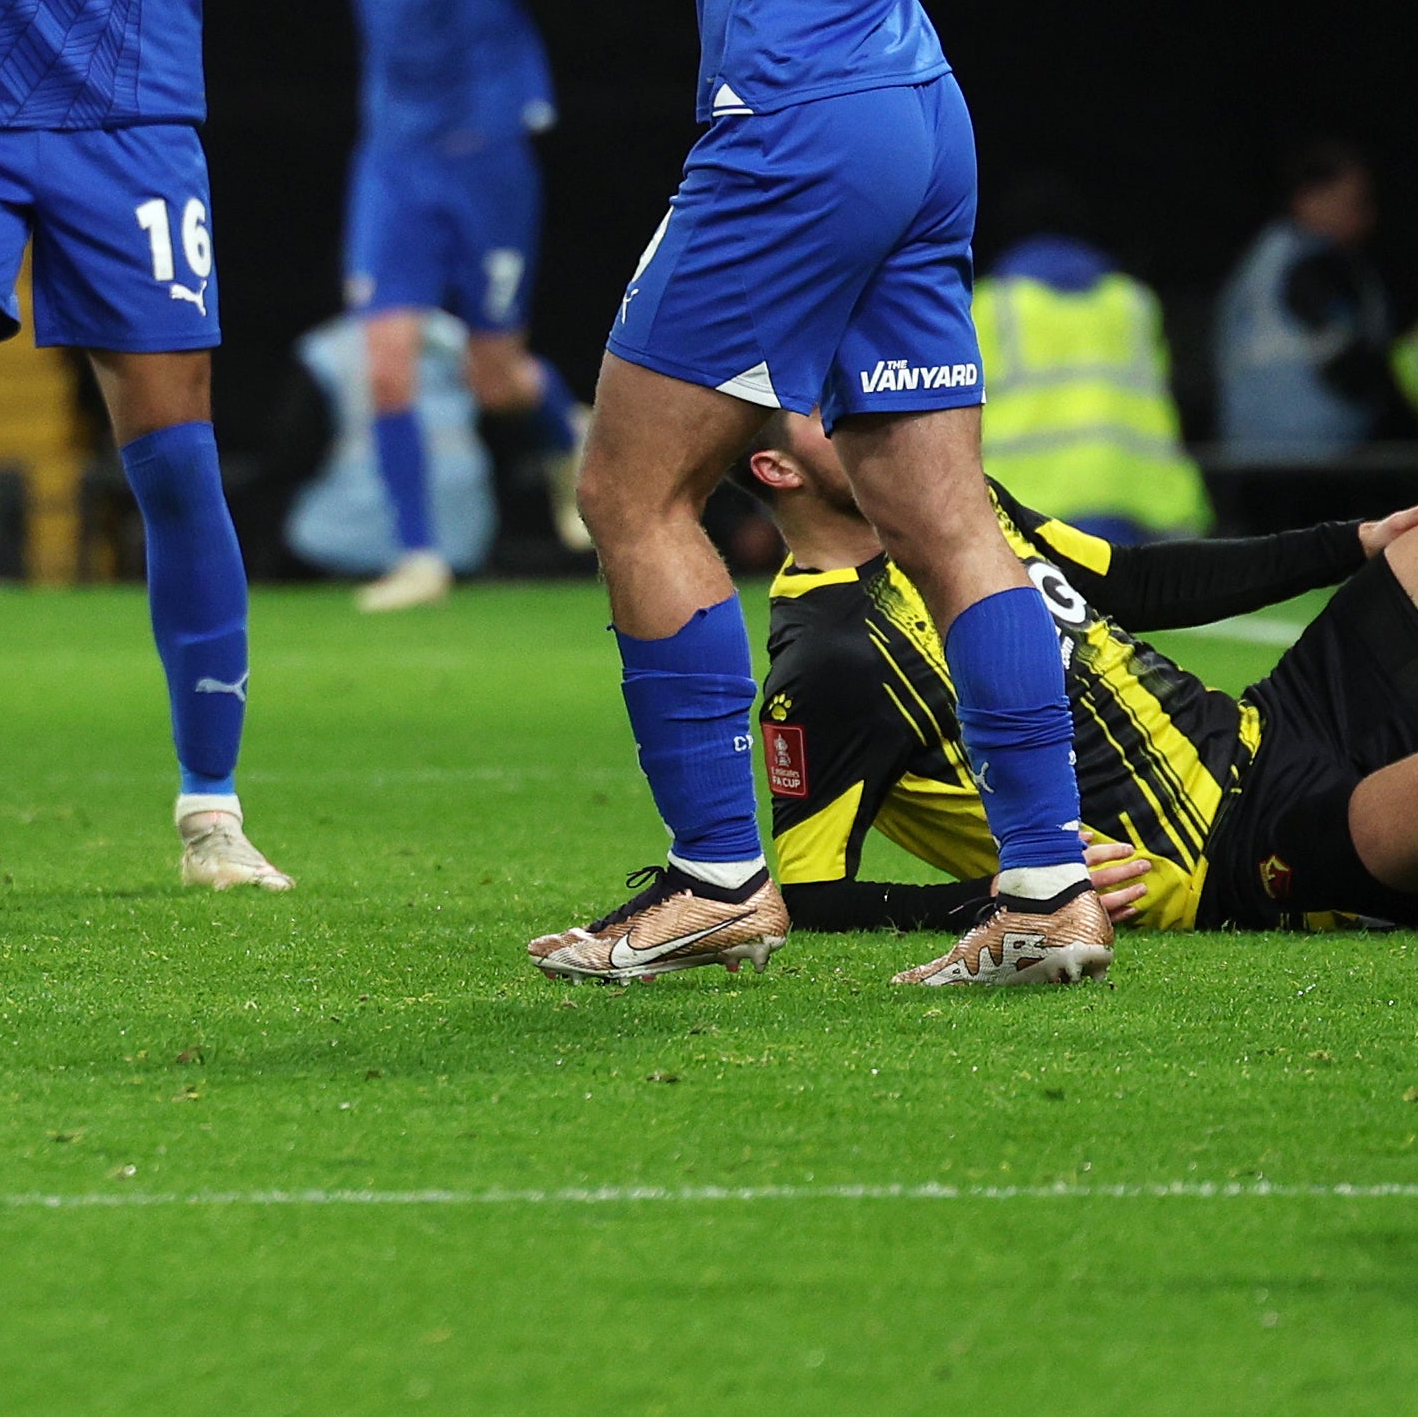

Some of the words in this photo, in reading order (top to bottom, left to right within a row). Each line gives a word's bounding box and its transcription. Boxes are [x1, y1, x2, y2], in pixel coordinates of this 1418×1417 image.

[135, 197, 213, 282] 16
[887, 359, 908, 370] THE
[860, 360, 978, 393] VANYARD
[772, 775, 782, 787] FA
[782, 777, 802, 789] CUP
